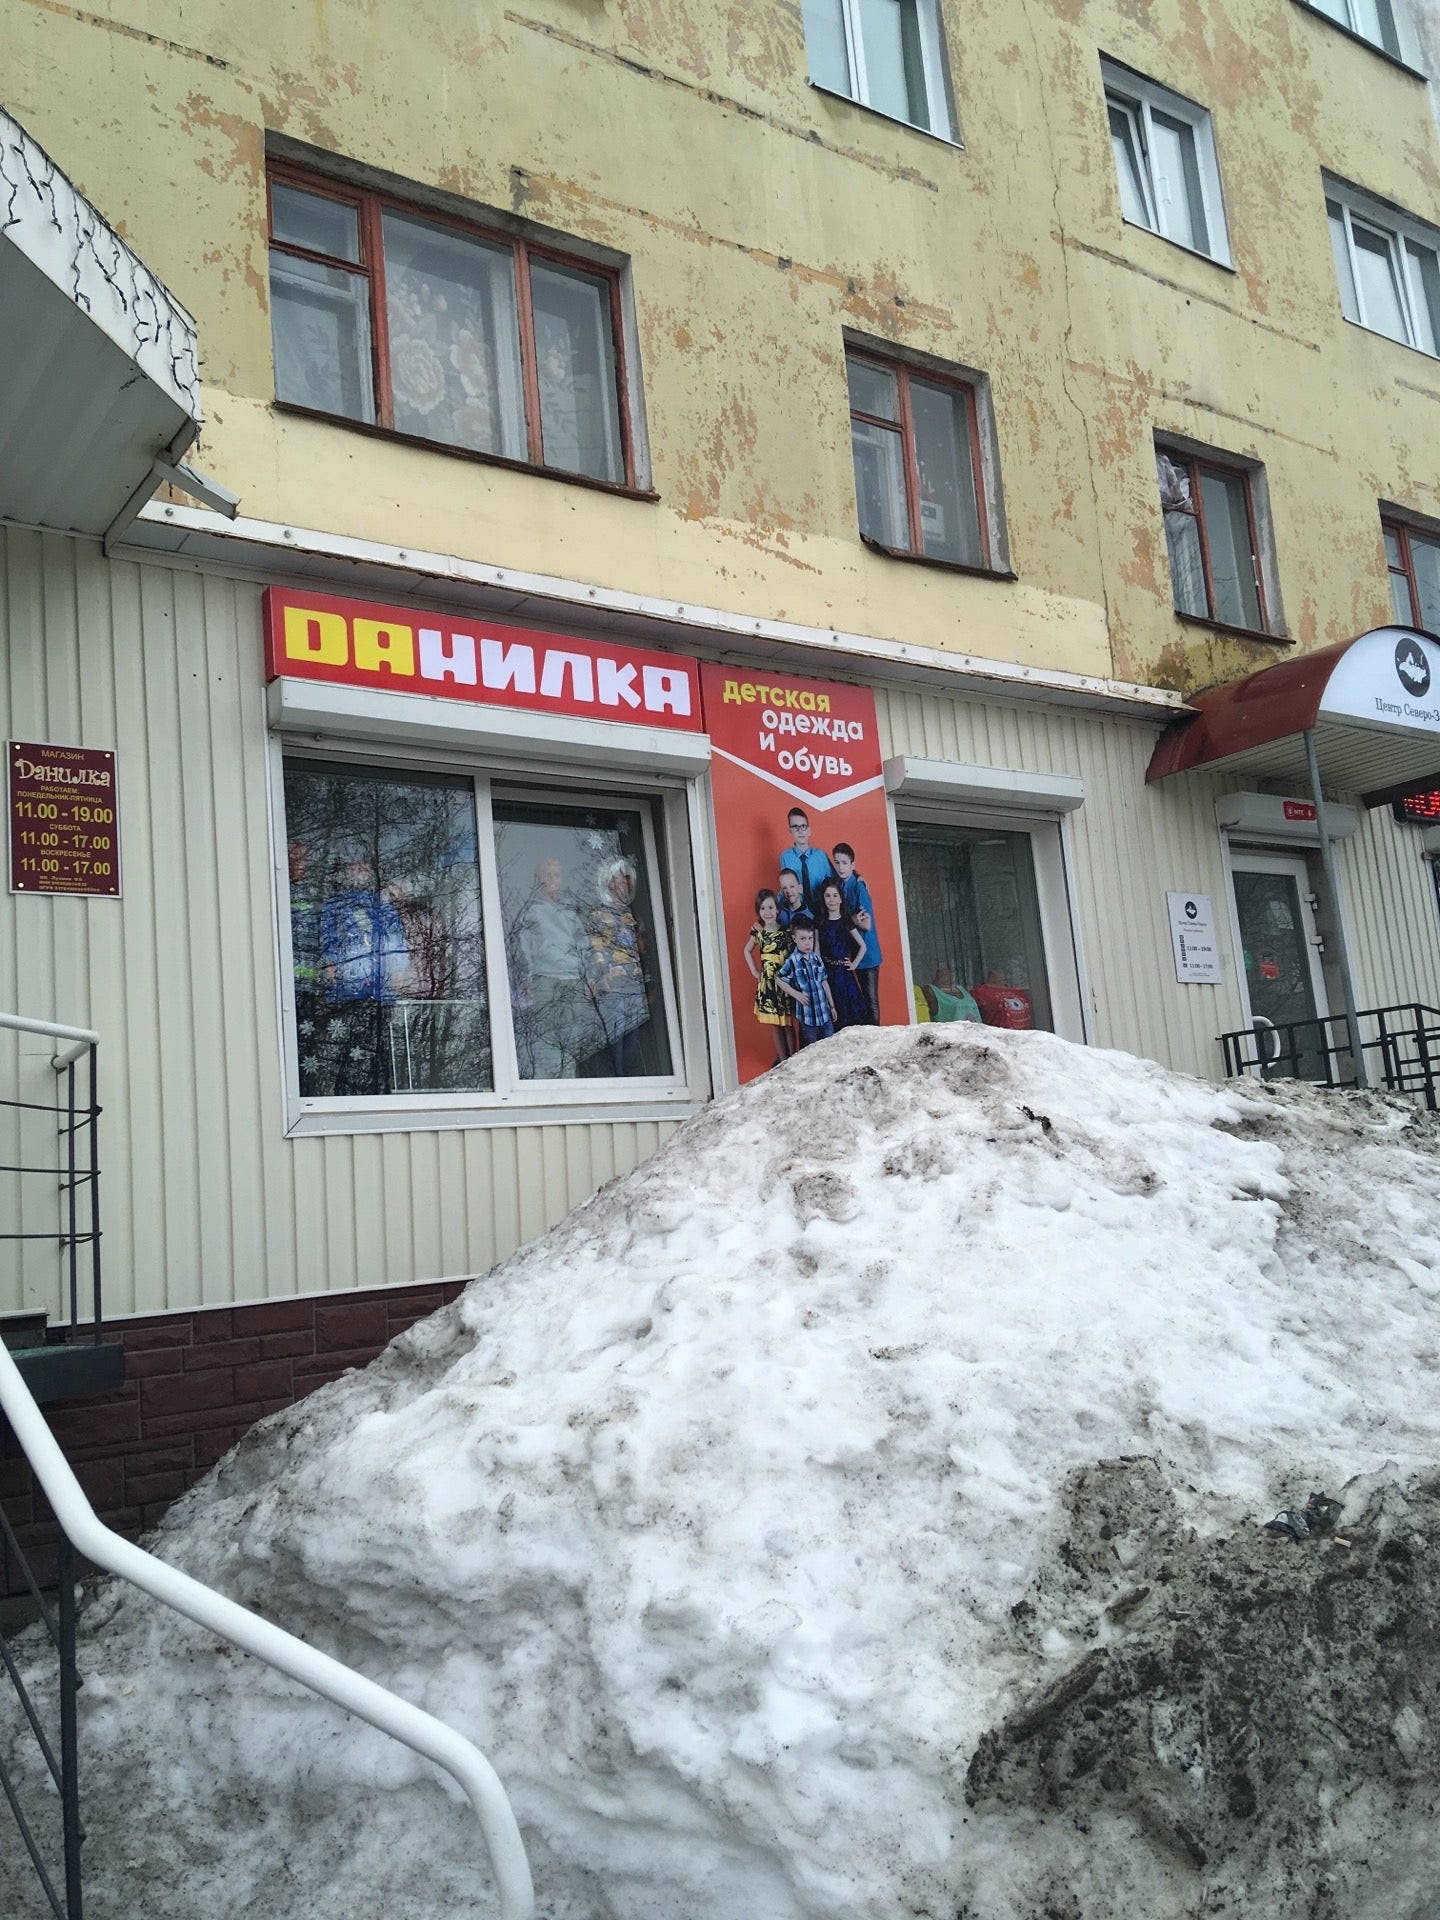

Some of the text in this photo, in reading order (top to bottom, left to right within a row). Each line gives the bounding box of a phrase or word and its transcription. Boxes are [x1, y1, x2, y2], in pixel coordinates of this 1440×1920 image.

[723, 680, 830, 712] детская
[1375, 697, 1440, 721] Центр Северо-З
[762, 709, 863, 742] одежда
[759, 731, 776, 752] и
[41, 750, 85, 760] МАГАЗИН
[777, 746, 853, 780] обувь
[15, 801, 57, 819] 11.00
[71, 806, 112, 824] 19.00
[49, 823, 81, 832] СУББОТА
[20, 831, 58, 846] 11.00
[72, 835, 110, 850] 17.00
[40, 849, 91, 858] ВОСКРЕСЕНЬЕ
[21, 858, 59, 873] 11.00
[72, 861, 111, 876] 17.00
